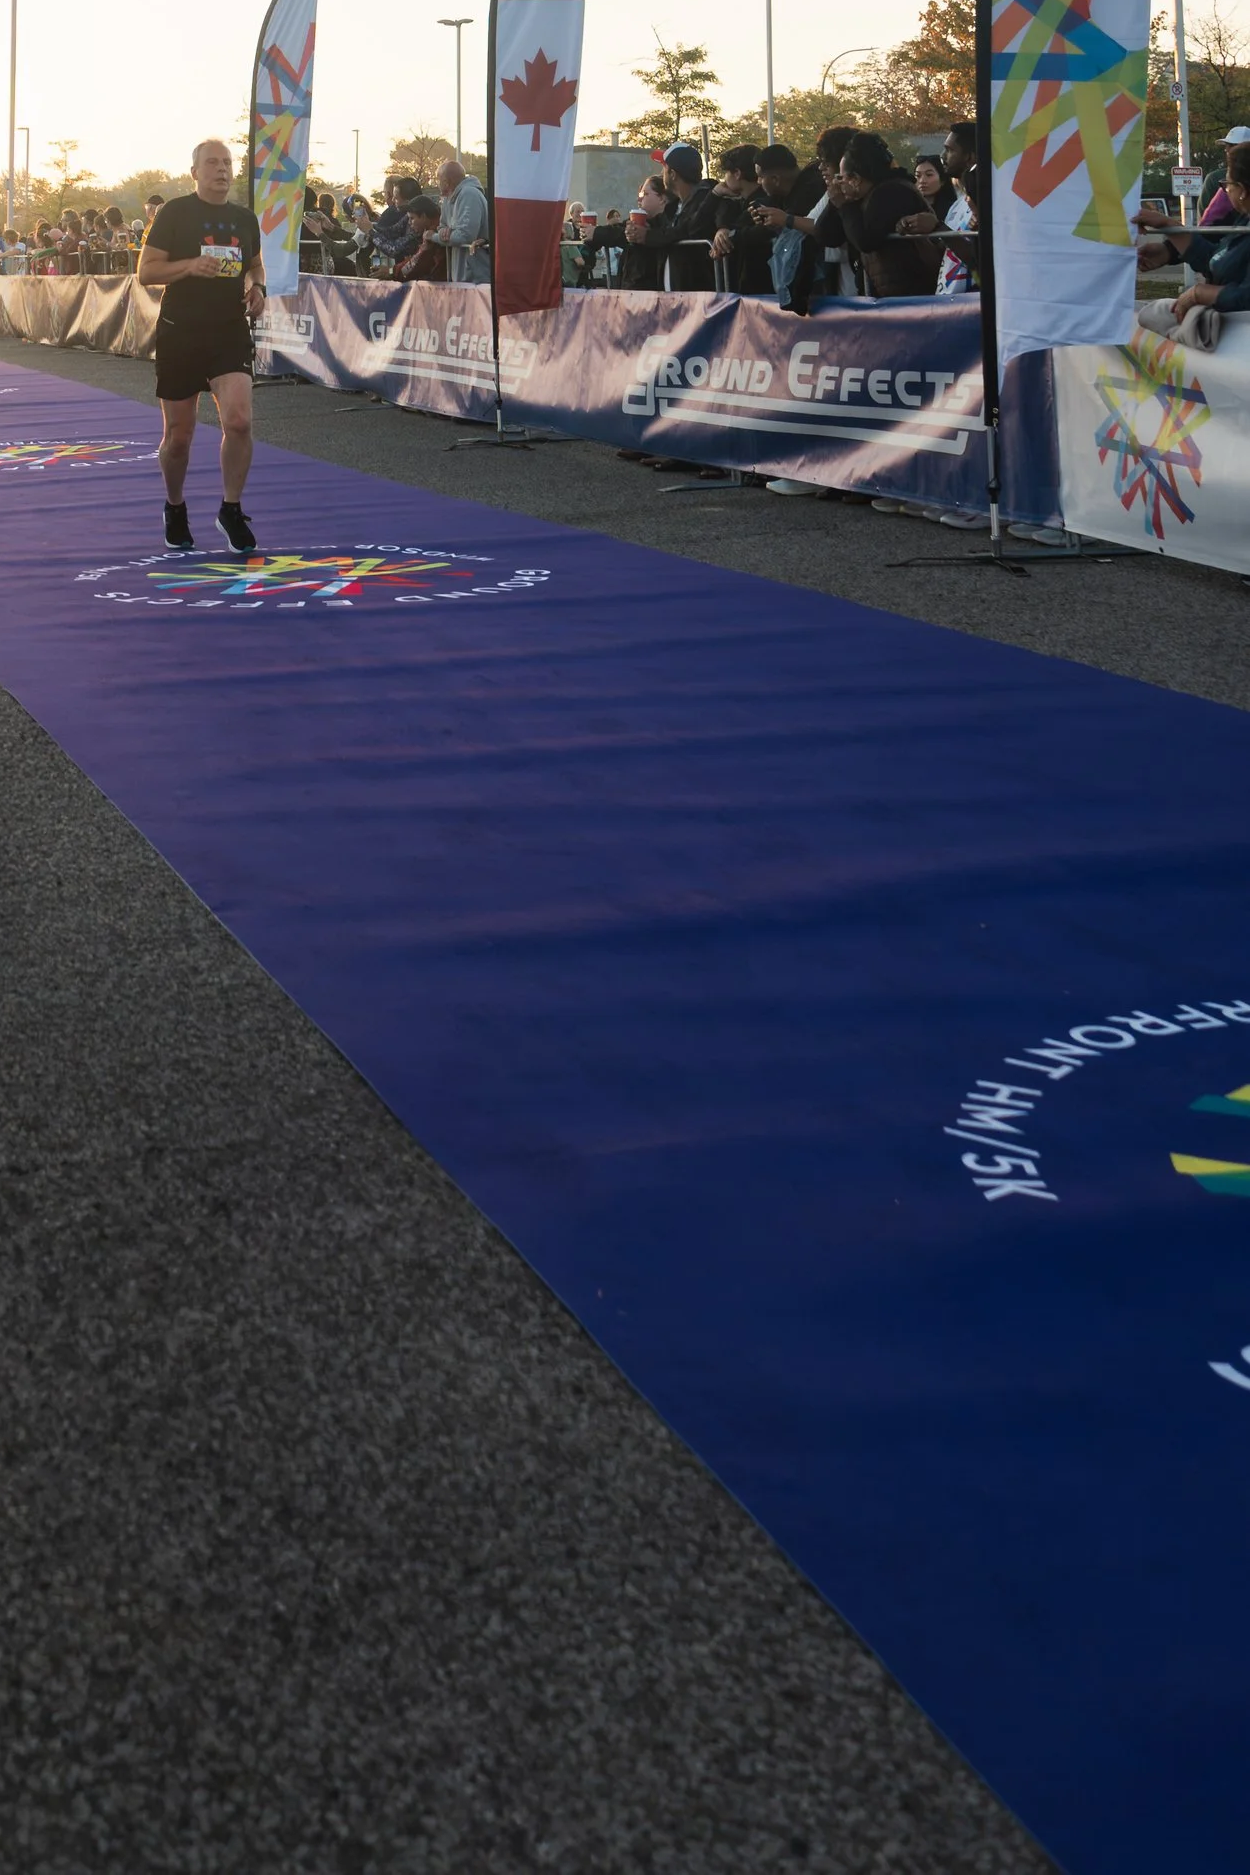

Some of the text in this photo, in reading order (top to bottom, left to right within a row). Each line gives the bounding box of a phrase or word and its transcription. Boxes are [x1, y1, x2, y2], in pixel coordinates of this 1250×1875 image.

[624, 334, 984, 412] GROUND EFFECTS
[93, 569, 552, 608] GROUND EFFECTS
[943, 1078, 1061, 1202] HM/5K
